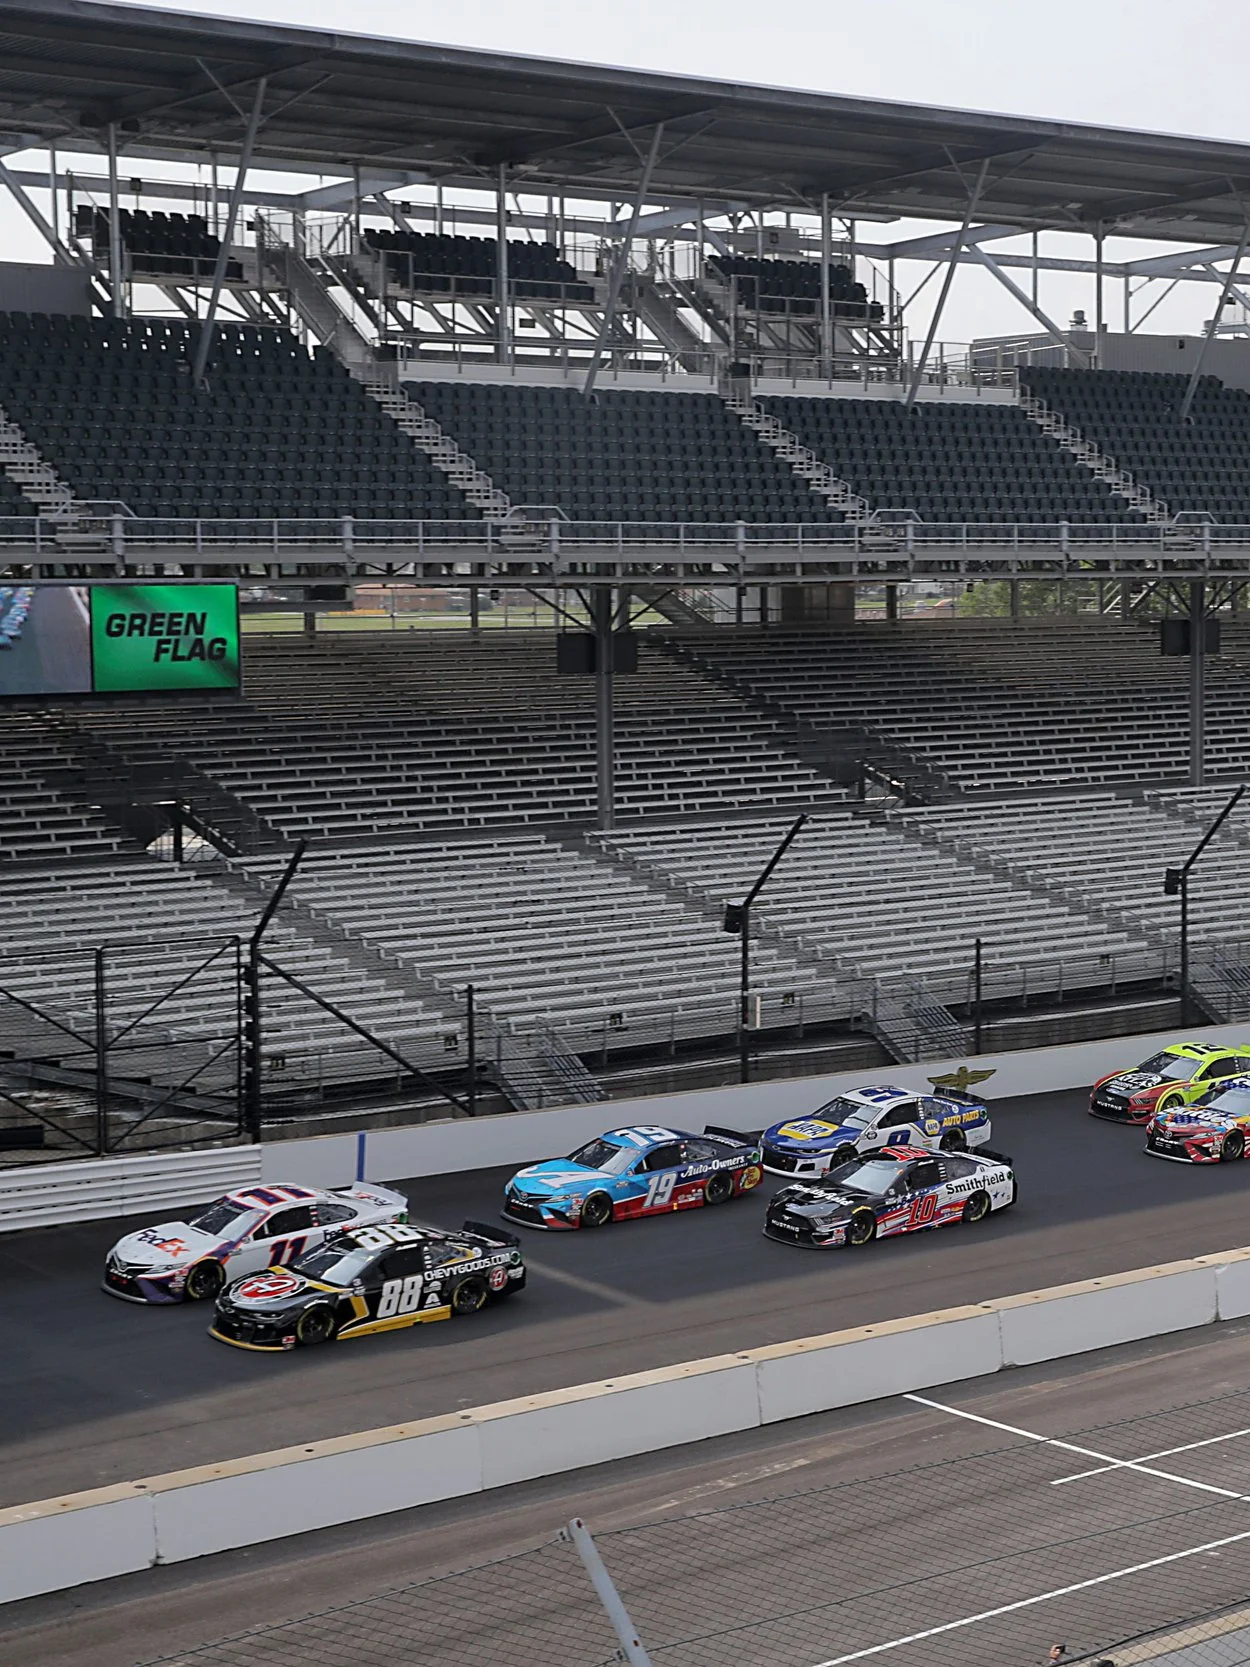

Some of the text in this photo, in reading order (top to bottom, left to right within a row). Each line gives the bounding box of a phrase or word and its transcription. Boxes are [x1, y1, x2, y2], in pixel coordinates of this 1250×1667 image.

[105, 612, 207, 638] GREEN
[153, 637, 228, 663] FLAG
[942, 1114, 961, 1127] AUTO
[962, 1109, 980, 1123] PARTS
[615, 1126, 681, 1147] 19
[680, 1155, 745, 1178] Auto-Owners
[236, 1187, 316, 1206] 11
[642, 1171, 678, 1209] 19
[946, 1172, 1005, 1195] Smithfield
[905, 1193, 938, 1226] 10
[771, 1219, 801, 1233] MUSTANG
[137, 1228, 190, 1257] FedEx
[269, 1236, 309, 1267] 11
[423, 1252, 511, 1281] CHEVYGOODS.COM
[376, 1274, 423, 1318] 88
